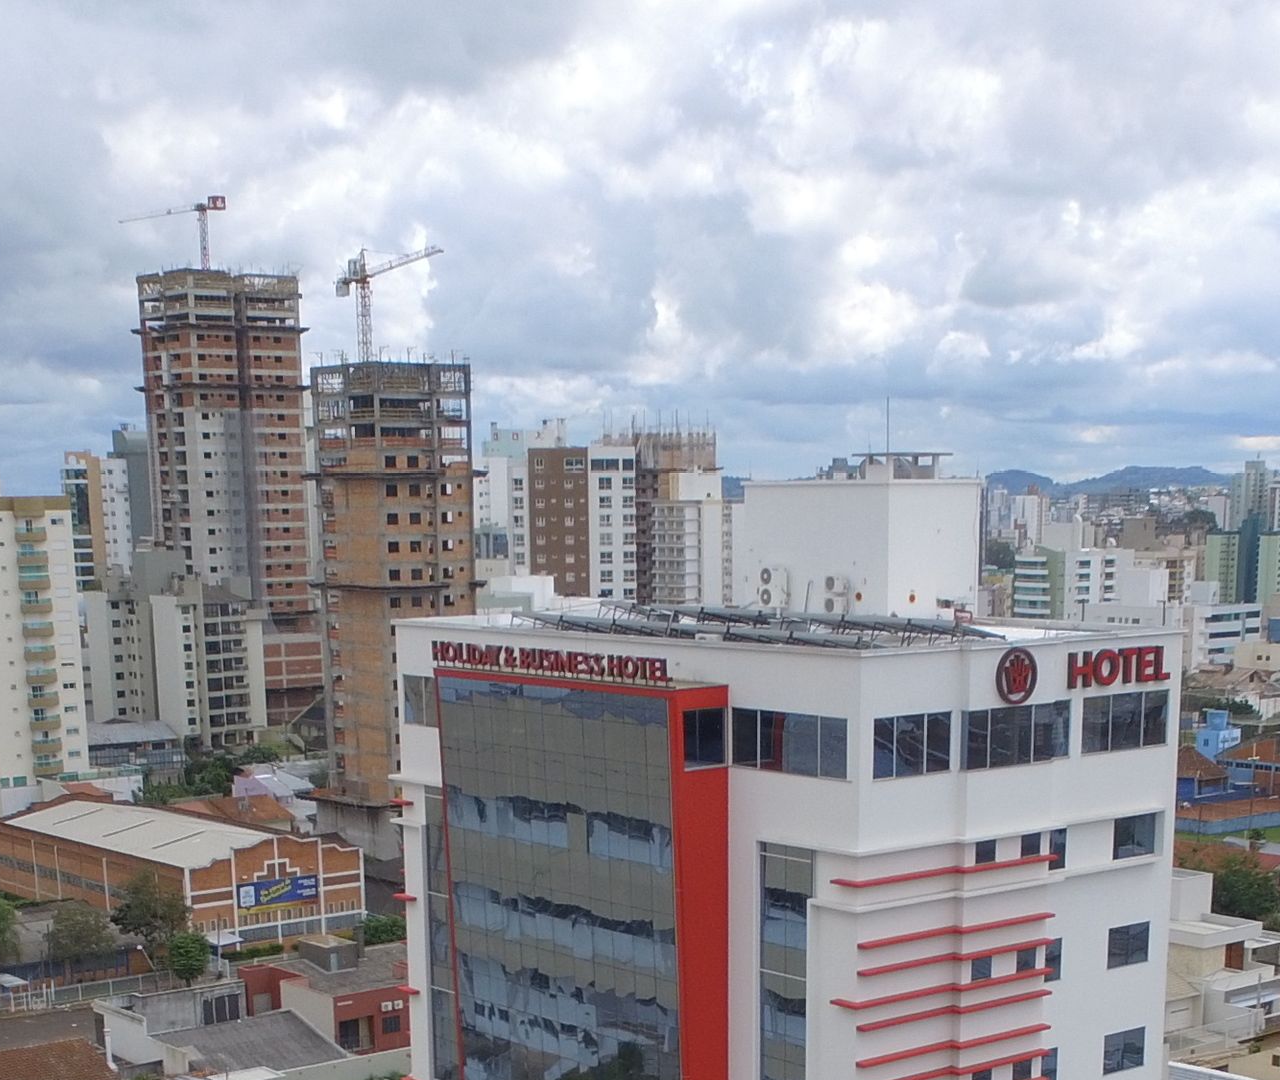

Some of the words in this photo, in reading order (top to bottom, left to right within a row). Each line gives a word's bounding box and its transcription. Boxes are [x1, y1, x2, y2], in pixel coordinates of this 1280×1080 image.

[431, 640, 502, 666] HOLIDAY
[504, 646, 517, 668] &
[519, 648, 605, 677] BUSINESS
[607, 654, 673, 683] HOTEL
[1067, 645, 1170, 689] HOTEL
